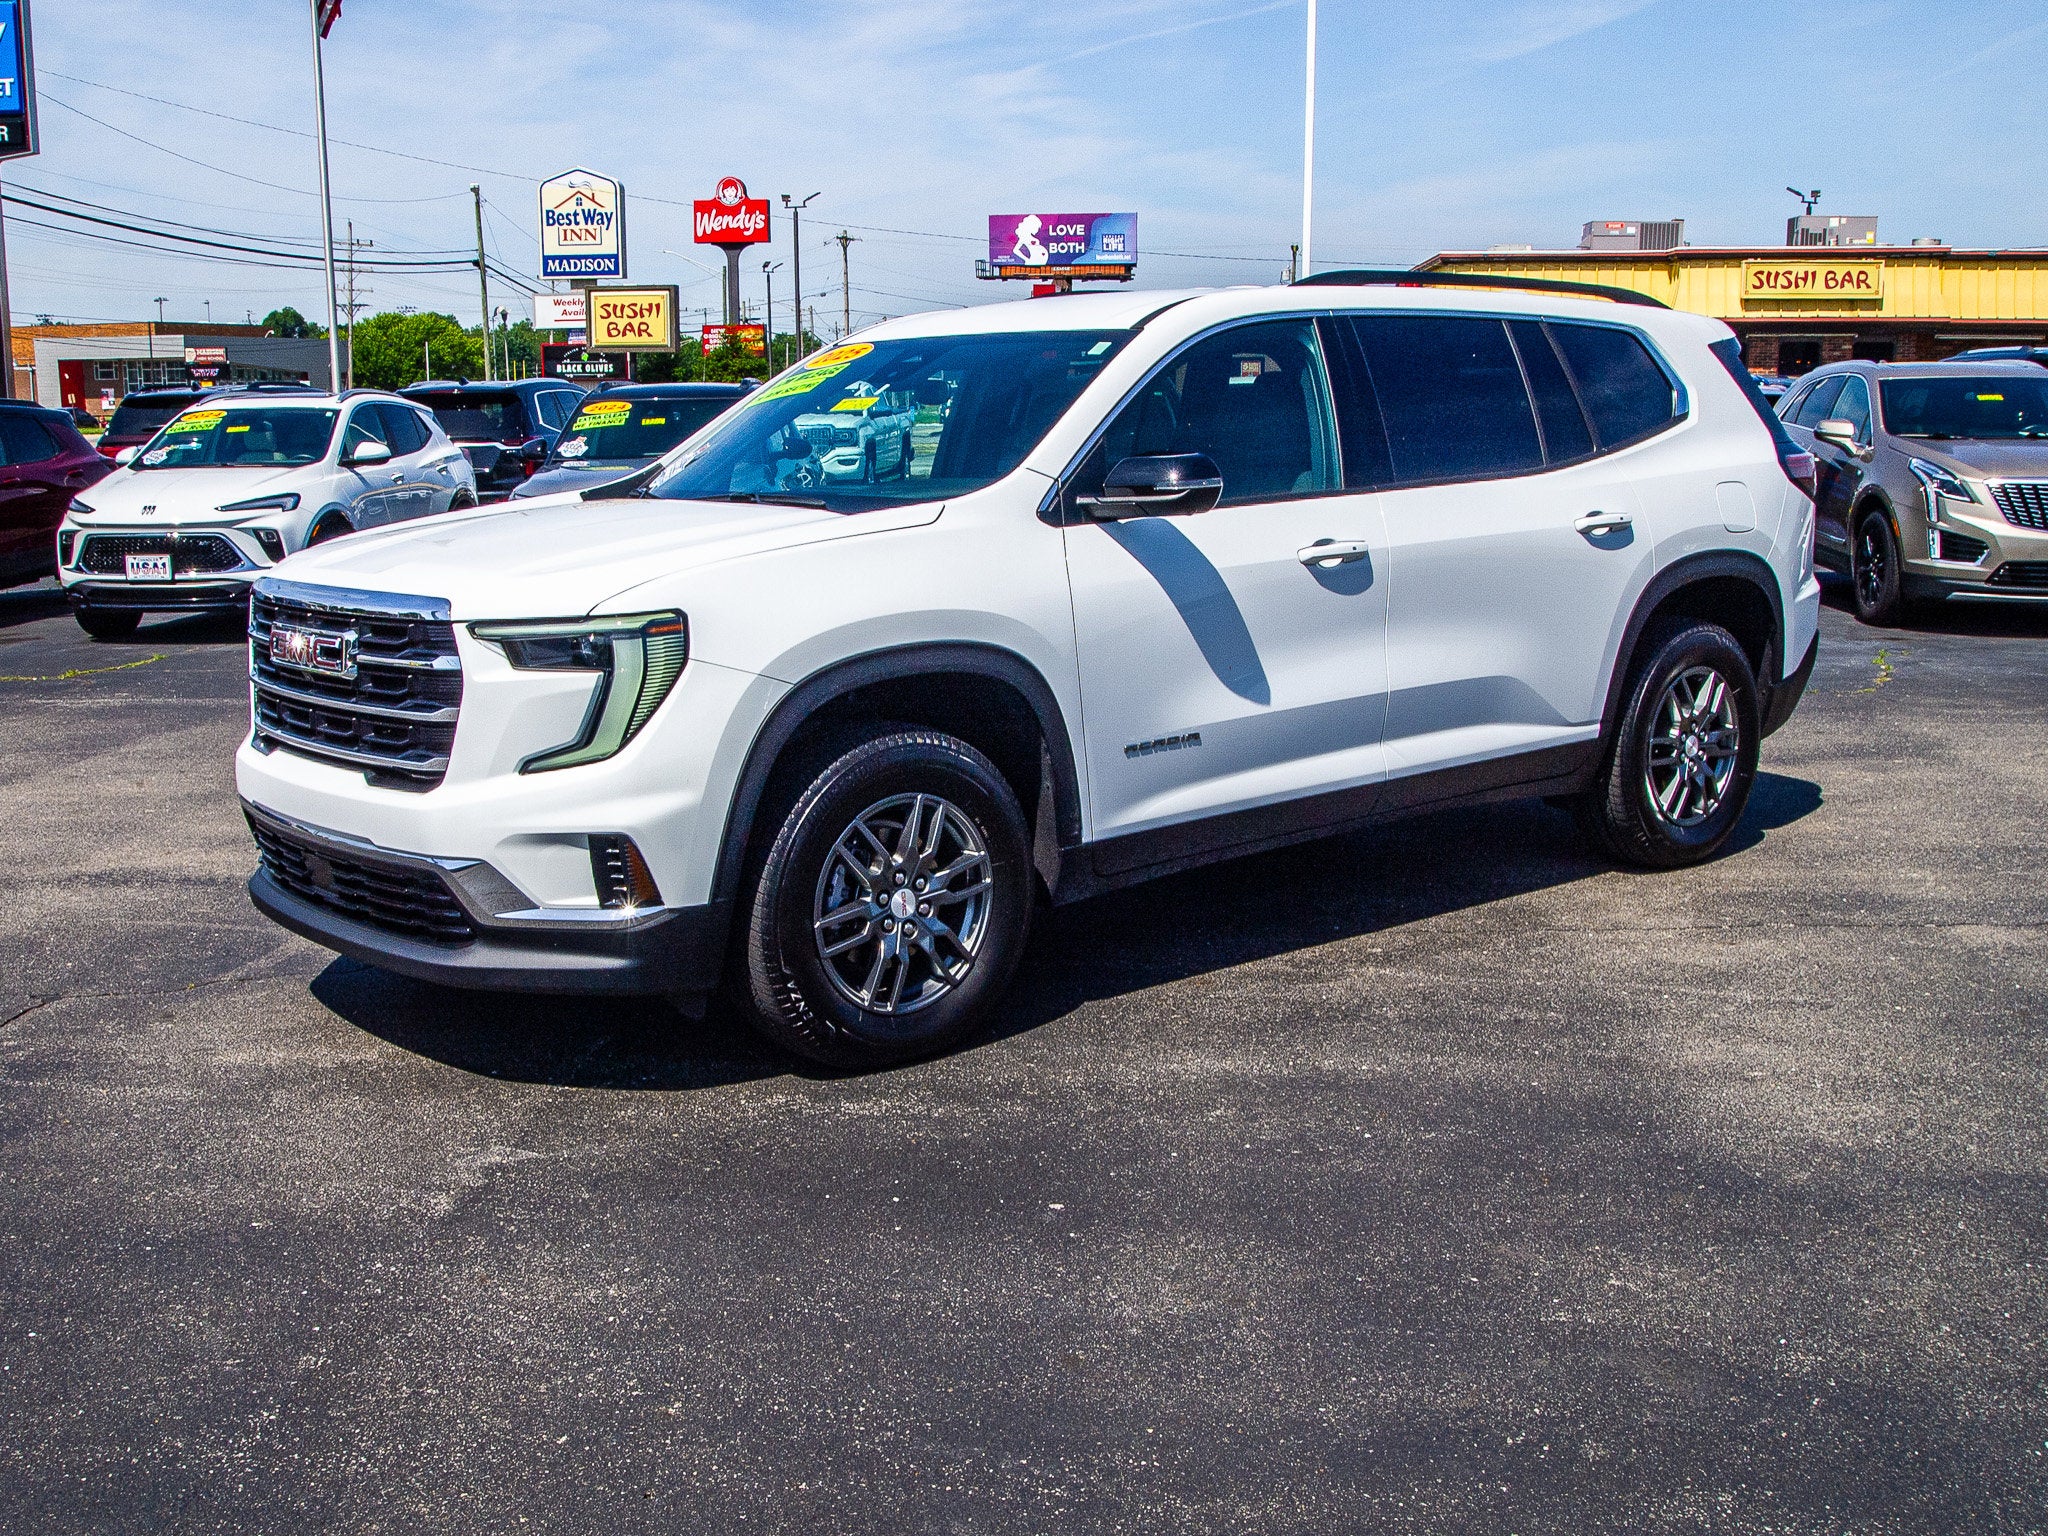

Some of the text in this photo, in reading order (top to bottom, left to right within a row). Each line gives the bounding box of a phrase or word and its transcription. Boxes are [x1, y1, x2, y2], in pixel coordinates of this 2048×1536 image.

[545, 206, 614, 231] Best Way
[696, 205, 765, 237] Wendy's
[562, 228, 598, 242] INN
[1049, 224, 1085, 236] LOVE
[1049, 242, 1085, 254] BOTH
[1103, 243, 1124, 252] LIFE
[547, 258, 615, 272] MADISON
[1752, 270, 1872, 290] SUSHI BAR
[553, 298, 585, 308] Weekly
[561, 309, 587, 317] Avail
[600, 303, 661, 319] SUSHI
[607, 322, 653, 338] BAR
[556, 363, 614, 373] BLACK OLIVES
[589, 404, 627, 412] 2024
[269, 629, 342, 671] GMC
